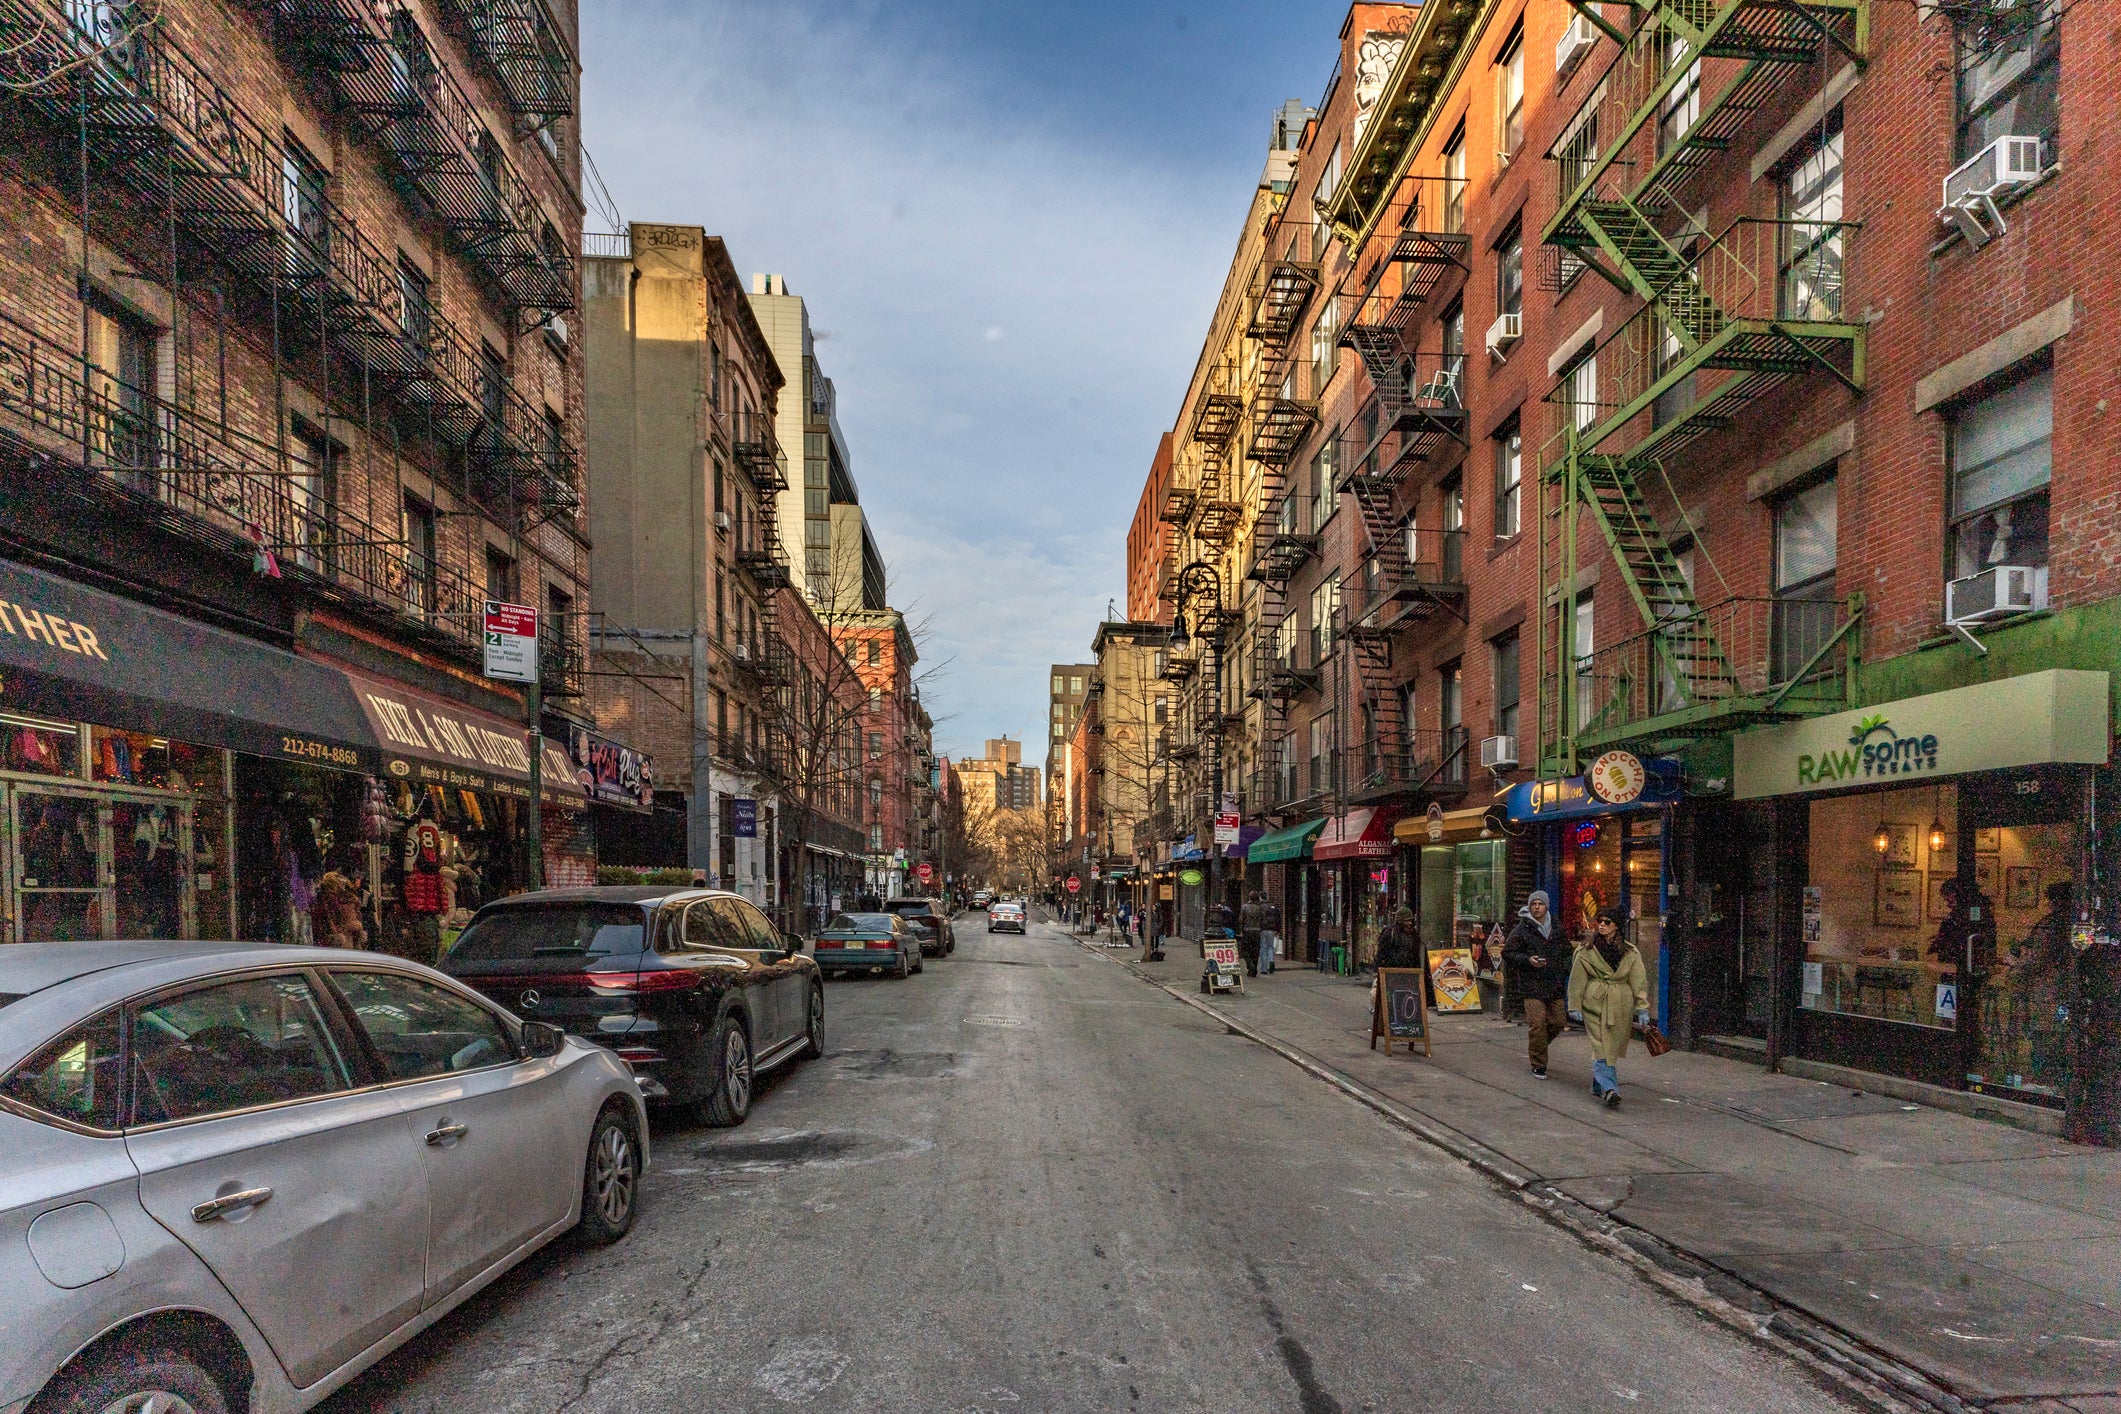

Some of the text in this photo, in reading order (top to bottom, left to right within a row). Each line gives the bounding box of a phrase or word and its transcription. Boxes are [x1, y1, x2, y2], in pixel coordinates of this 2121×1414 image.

[510, 607, 534, 616] STANDING
[489, 632, 498, 645] 2
[366, 693, 428, 749] NICK
[432, 714, 477, 760] SON
[282, 736, 358, 765] 212-674-8868
[393, 762, 407, 774] 161
[420, 765, 440, 780] Men's
[442, 769, 448, 781] &
[1594, 752, 1643, 784] GNOCCHI
[1863, 756, 1937, 777] TREATS
[1594, 781, 1639, 802] ON 9TH
[2016, 780, 2041, 795] 158
[1577, 827, 1596, 844] OPEN
[1358, 847, 1392, 855] LEATHER
[918, 867, 931, 875] STOP
[1215, 949, 1235, 964] 99
[1940, 989, 1955, 1009] A
